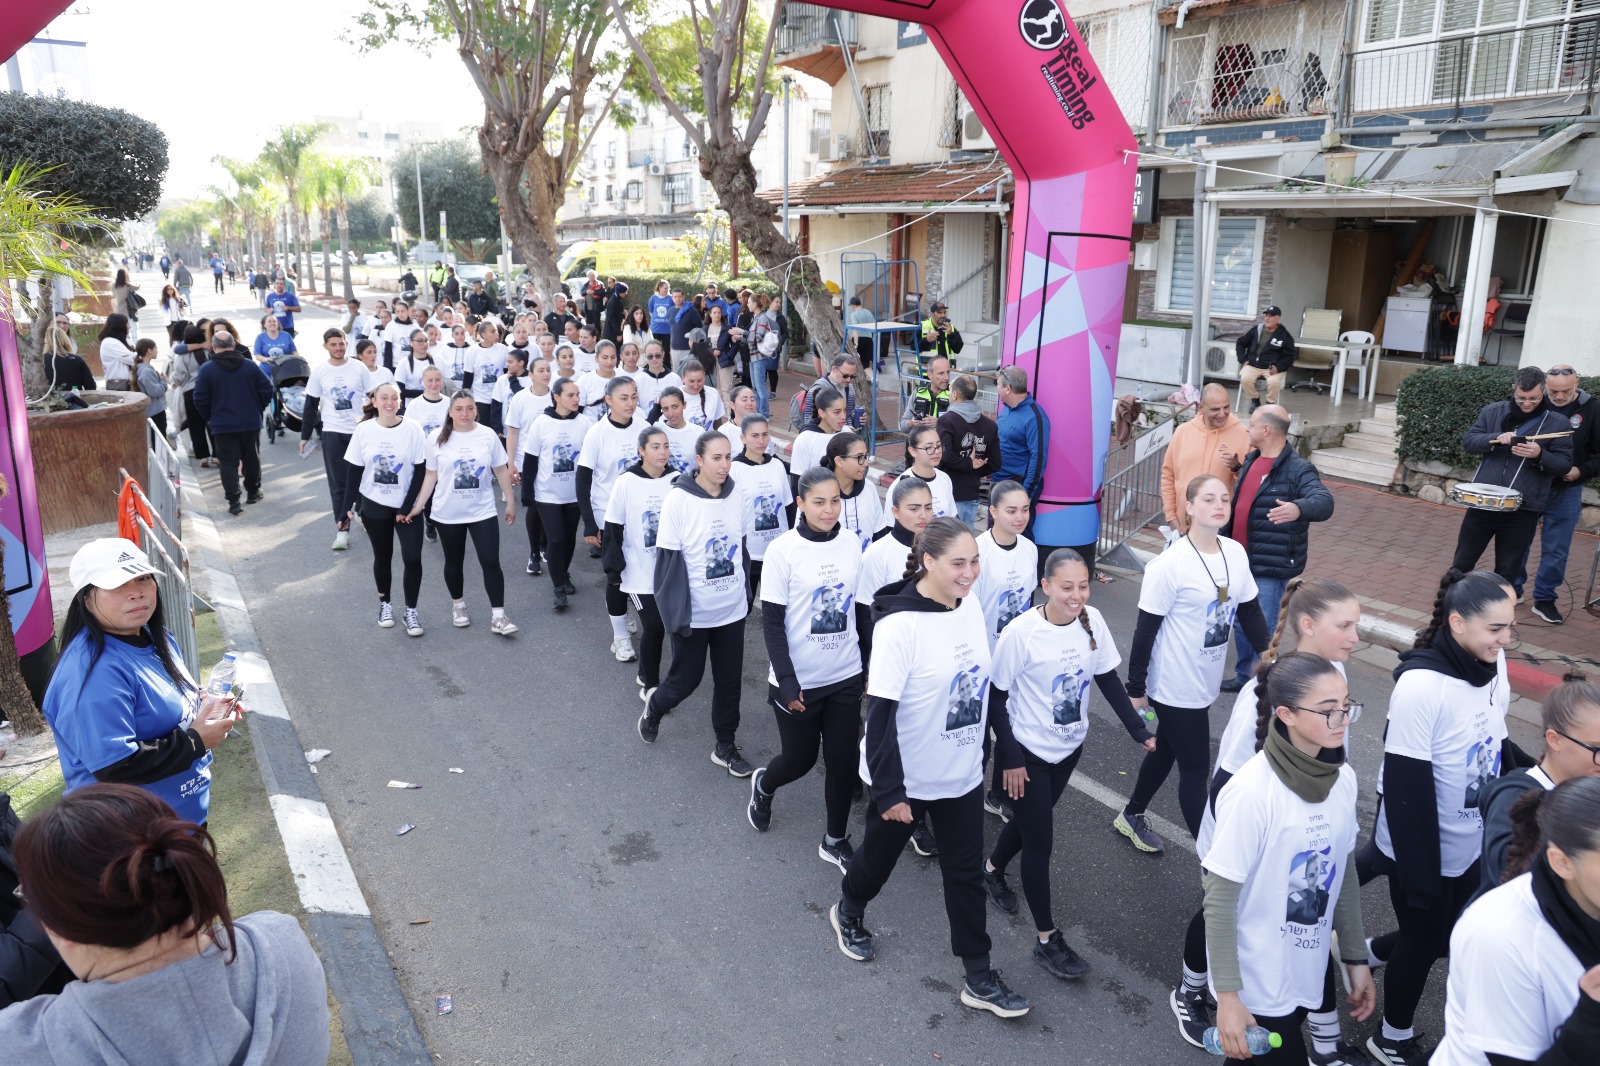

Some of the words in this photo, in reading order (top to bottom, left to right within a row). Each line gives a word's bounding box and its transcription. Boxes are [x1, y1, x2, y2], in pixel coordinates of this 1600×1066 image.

[1063, 37, 1097, 91] Real
[1041, 65, 1075, 118] realtiming.co.il
[1047, 48, 1095, 130] Timing
[821, 642, 839, 650] 2025
[940, 729, 964, 742] ישראל
[956, 735, 976, 747] 2025
[1457, 809, 1480, 819] שראל
[1294, 937, 1321, 949] 2025
